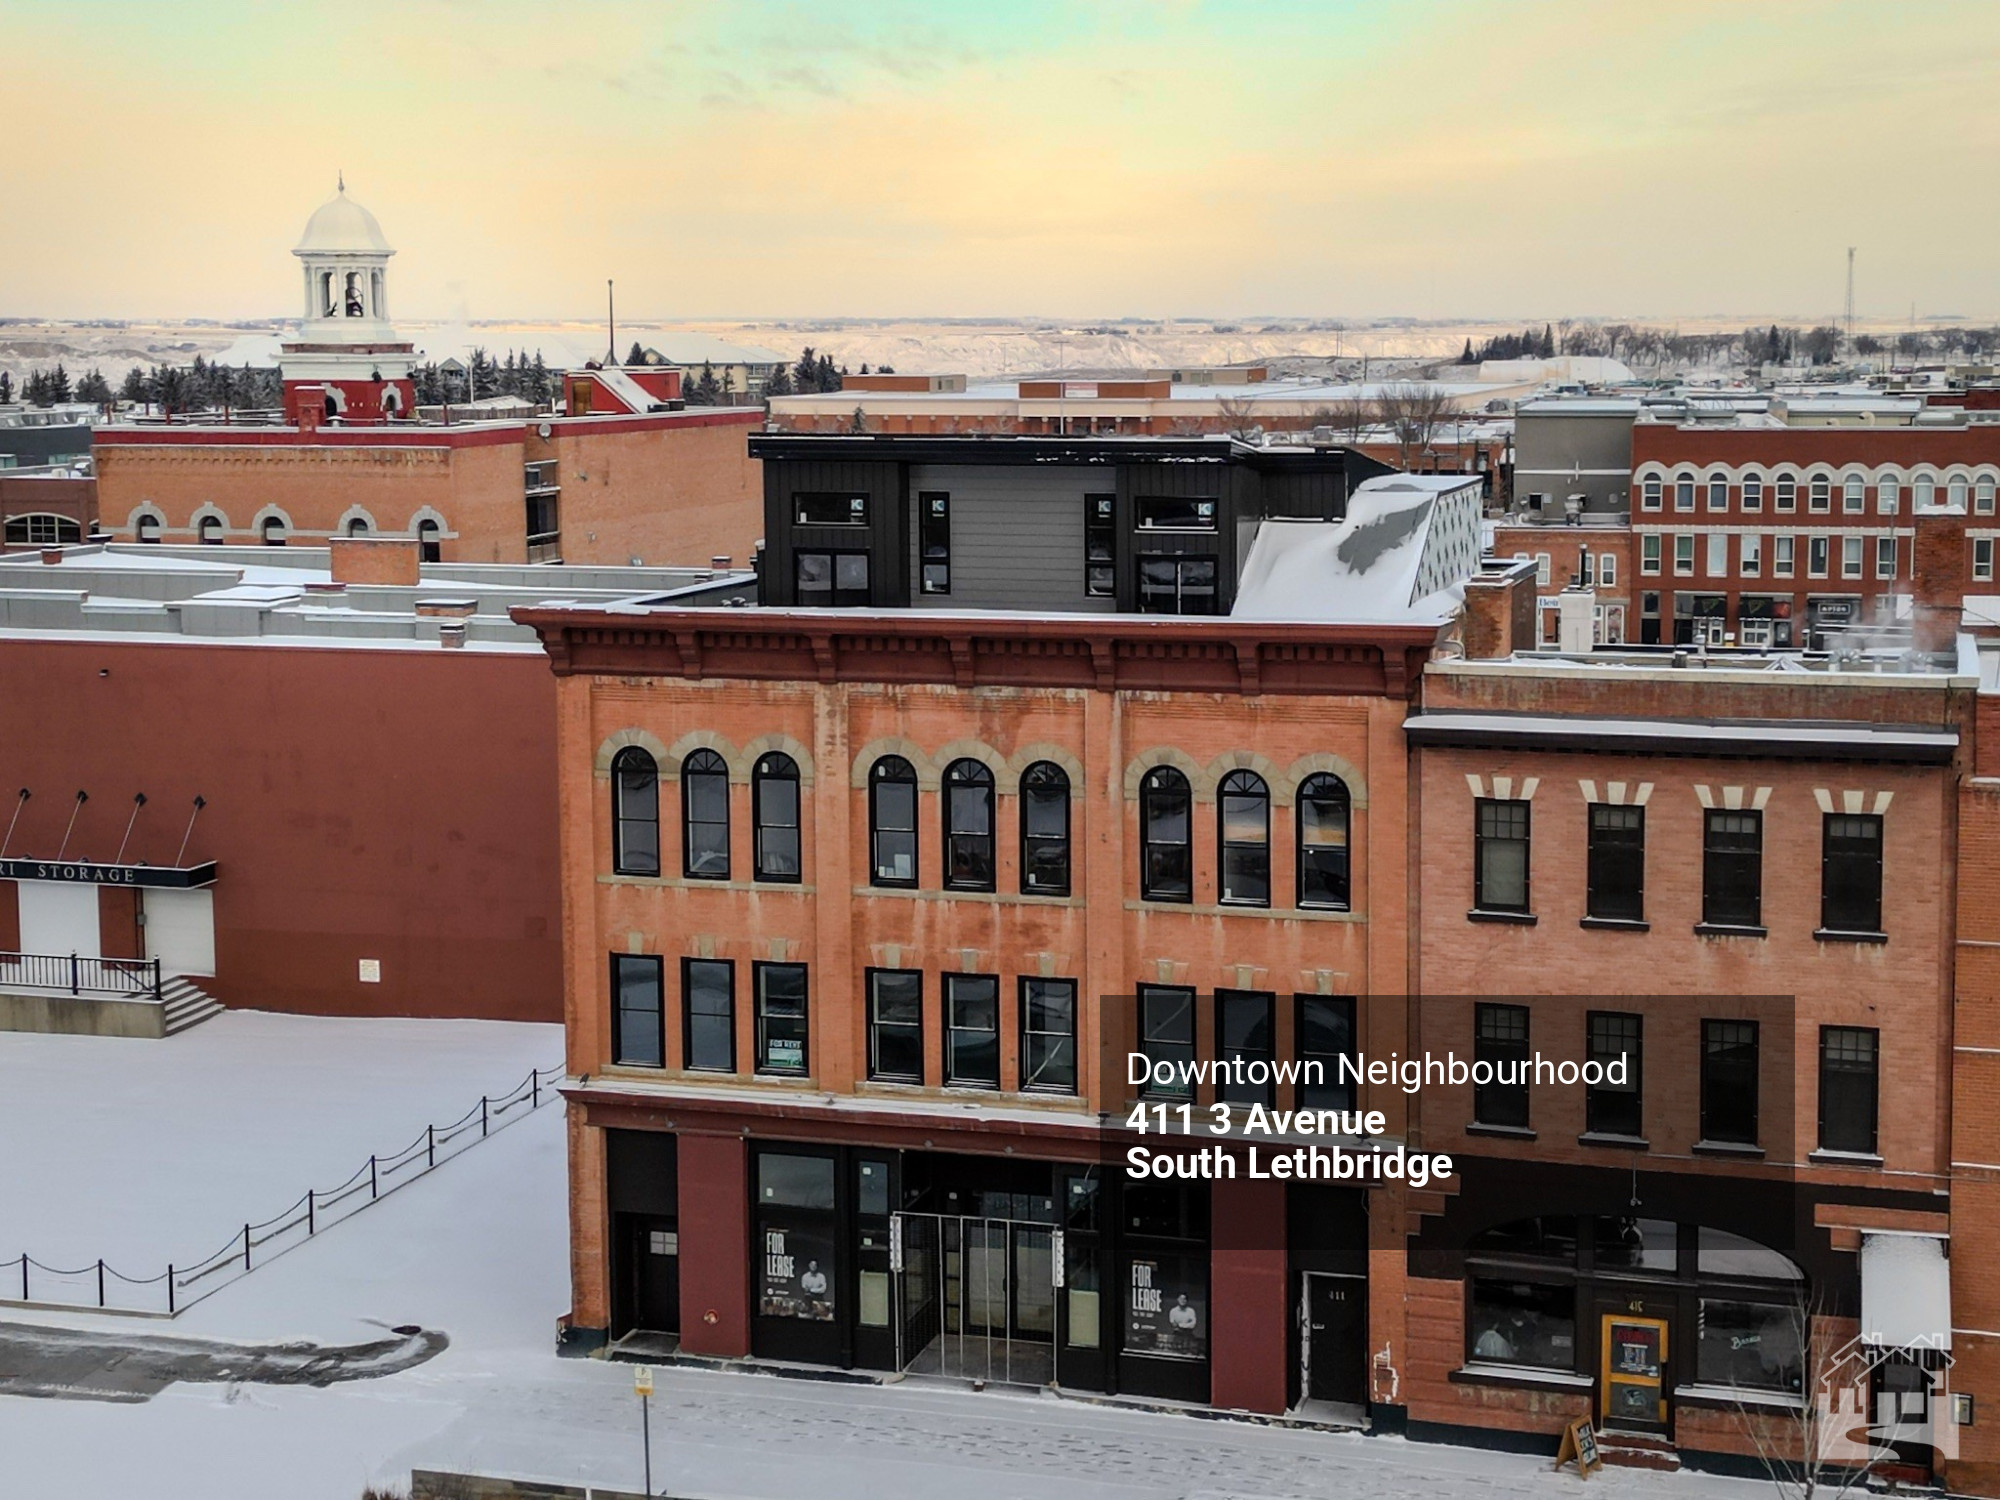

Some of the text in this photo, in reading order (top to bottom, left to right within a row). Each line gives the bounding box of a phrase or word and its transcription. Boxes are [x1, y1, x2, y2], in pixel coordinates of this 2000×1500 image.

[38, 864, 135, 883] STORAGE
[770, 1039, 783, 1048] FOR
[766, 1232, 785, 1255] FOR
[766, 1254, 795, 1278] LEASE
[1132, 1264, 1152, 1288] FOR
[1132, 1287, 1162, 1312] LEASE
